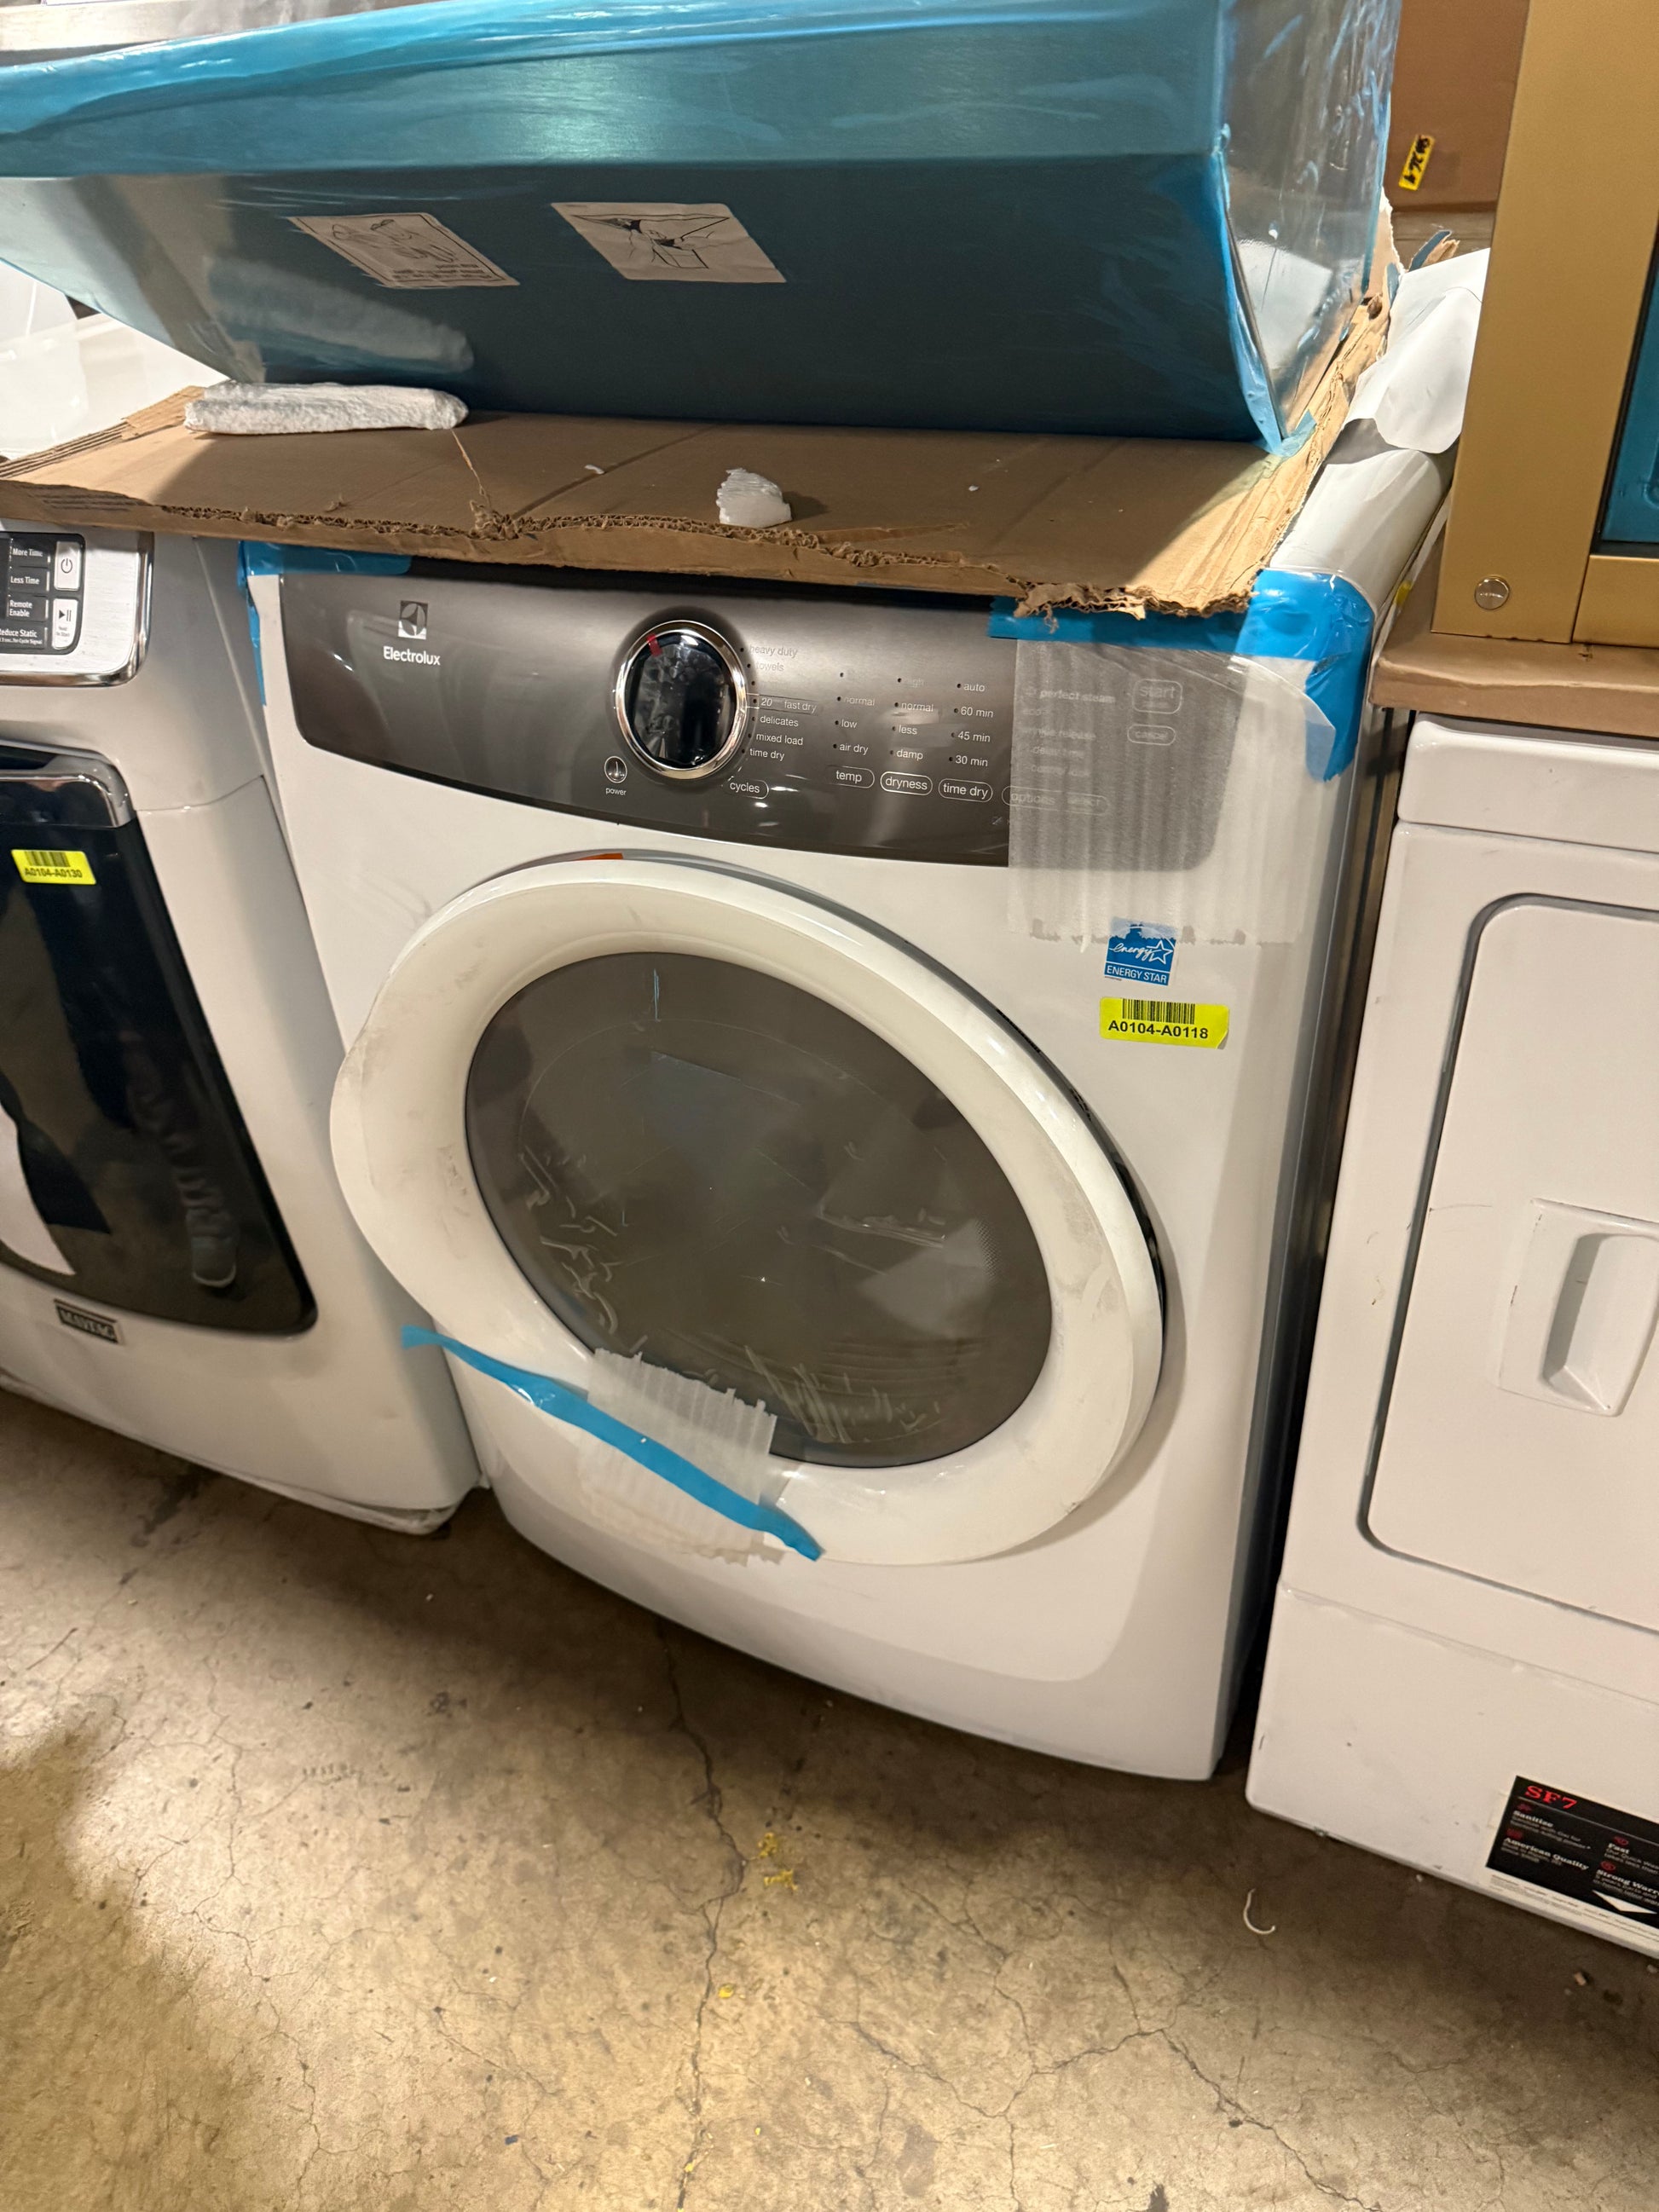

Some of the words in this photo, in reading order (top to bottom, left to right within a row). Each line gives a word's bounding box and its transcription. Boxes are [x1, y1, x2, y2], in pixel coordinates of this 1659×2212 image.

[12, 547, 28, 557] More
[28, 548, 43, 557] Time
[10, 575, 24, 585] Less
[25, 576, 40, 586] Time
[9, 599, 32, 609] Remote
[9, 609, 30, 618] Enable
[20, 628, 38, 638] Static
[383, 644, 442, 666] Electrolux
[777, 647, 799, 659] duty
[962, 683, 986, 692] auto
[760, 697, 773, 707] 20
[784, 700, 801, 710] fast
[801, 702, 818, 714] dry
[843, 697, 876, 707] normal
[900, 702, 934, 713] normal
[960, 706, 973, 716] 60
[975, 708, 994, 719] min
[759, 716, 799, 727] delicates
[841, 719, 858, 729] low
[899, 725, 918, 735] less
[957, 731, 970, 741] 45
[973, 733, 991, 742] min
[755, 733, 783, 743] mixed
[784, 735, 804, 746] load
[749, 748, 768, 758] time
[770, 750, 785, 762] dry
[839, 742, 851, 751] air
[853, 744, 869, 756] dry
[896, 748, 923, 761] damp
[955, 754, 968, 765] 30
[970, 757, 988, 767] min
[835, 770, 863, 784] temp
[885, 776, 928, 791] dryness
[605, 788, 627, 796] power
[729, 781, 760, 794] cycles
[942, 783, 967, 795] time
[969, 786, 989, 800] dry
[24, 868, 83, 879] A0104-A0130
[1106, 965, 1143, 980] ENERGY
[1143, 971, 1167, 984] STAR
[1108, 1019, 1209, 1039] A0104-A0118
[1524, 1785, 1578, 1809] SF7
[1512, 1810, 1554, 1828] Sanitize
[1503, 1837, 1552, 1857] American
[1552, 1853, 1590, 1871] Quality
[1607, 1842, 1630, 1854] Fast
[1596, 1868, 1631, 1886] Strong
